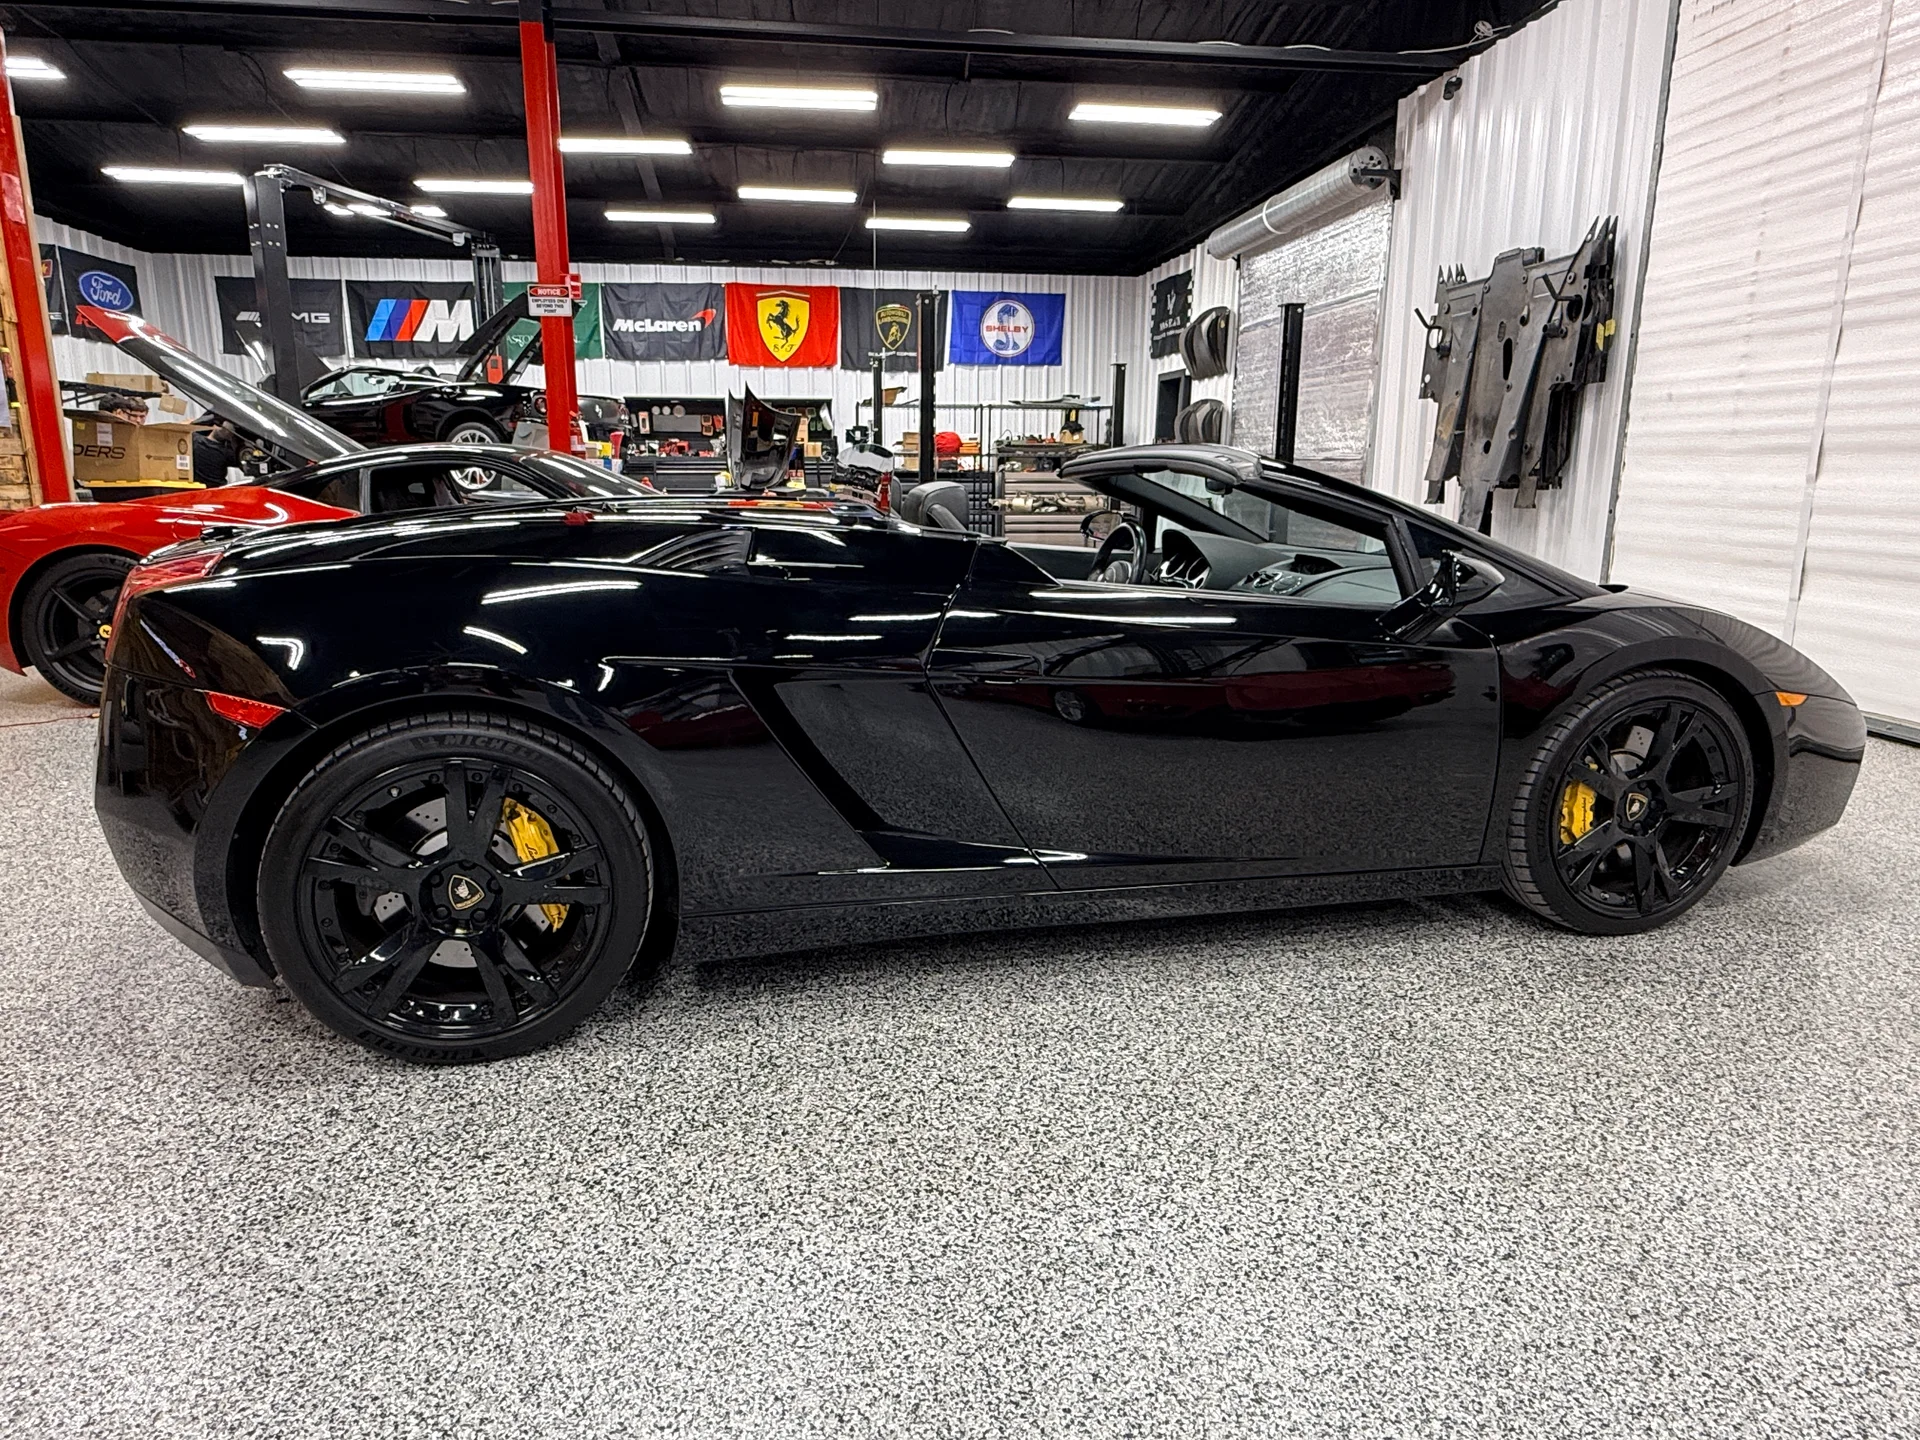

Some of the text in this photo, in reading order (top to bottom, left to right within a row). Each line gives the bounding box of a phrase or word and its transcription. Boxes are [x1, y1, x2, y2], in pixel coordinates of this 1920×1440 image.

[90, 276, 122, 306] Ford
[537, 288, 561, 296] NOTICE
[612, 318, 702, 333] McLaren
[985, 325, 1029, 333] SHELBY
